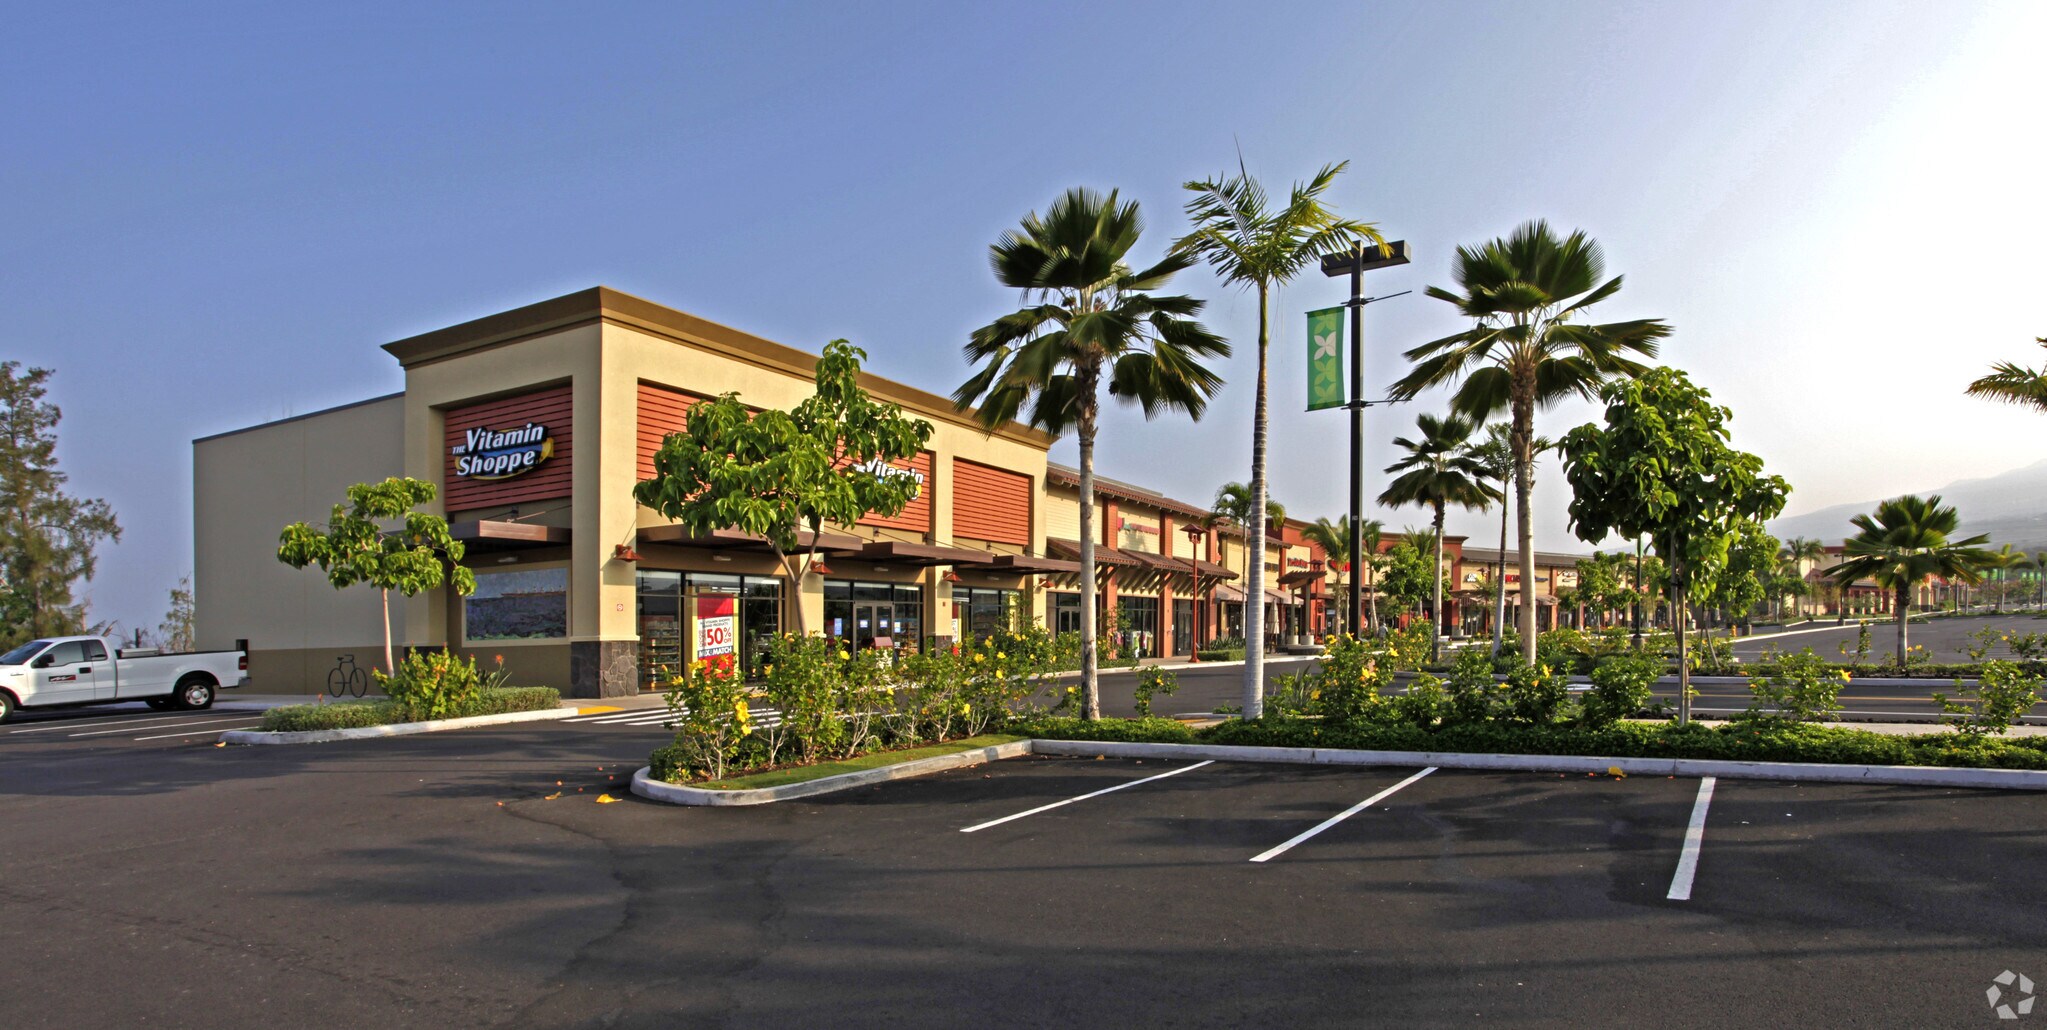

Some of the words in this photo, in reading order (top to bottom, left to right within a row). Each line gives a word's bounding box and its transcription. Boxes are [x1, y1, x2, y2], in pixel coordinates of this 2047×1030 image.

[452, 445, 465, 454] THE
[466, 423, 544, 452] Vitamin
[457, 450, 535, 475] Shoppe
